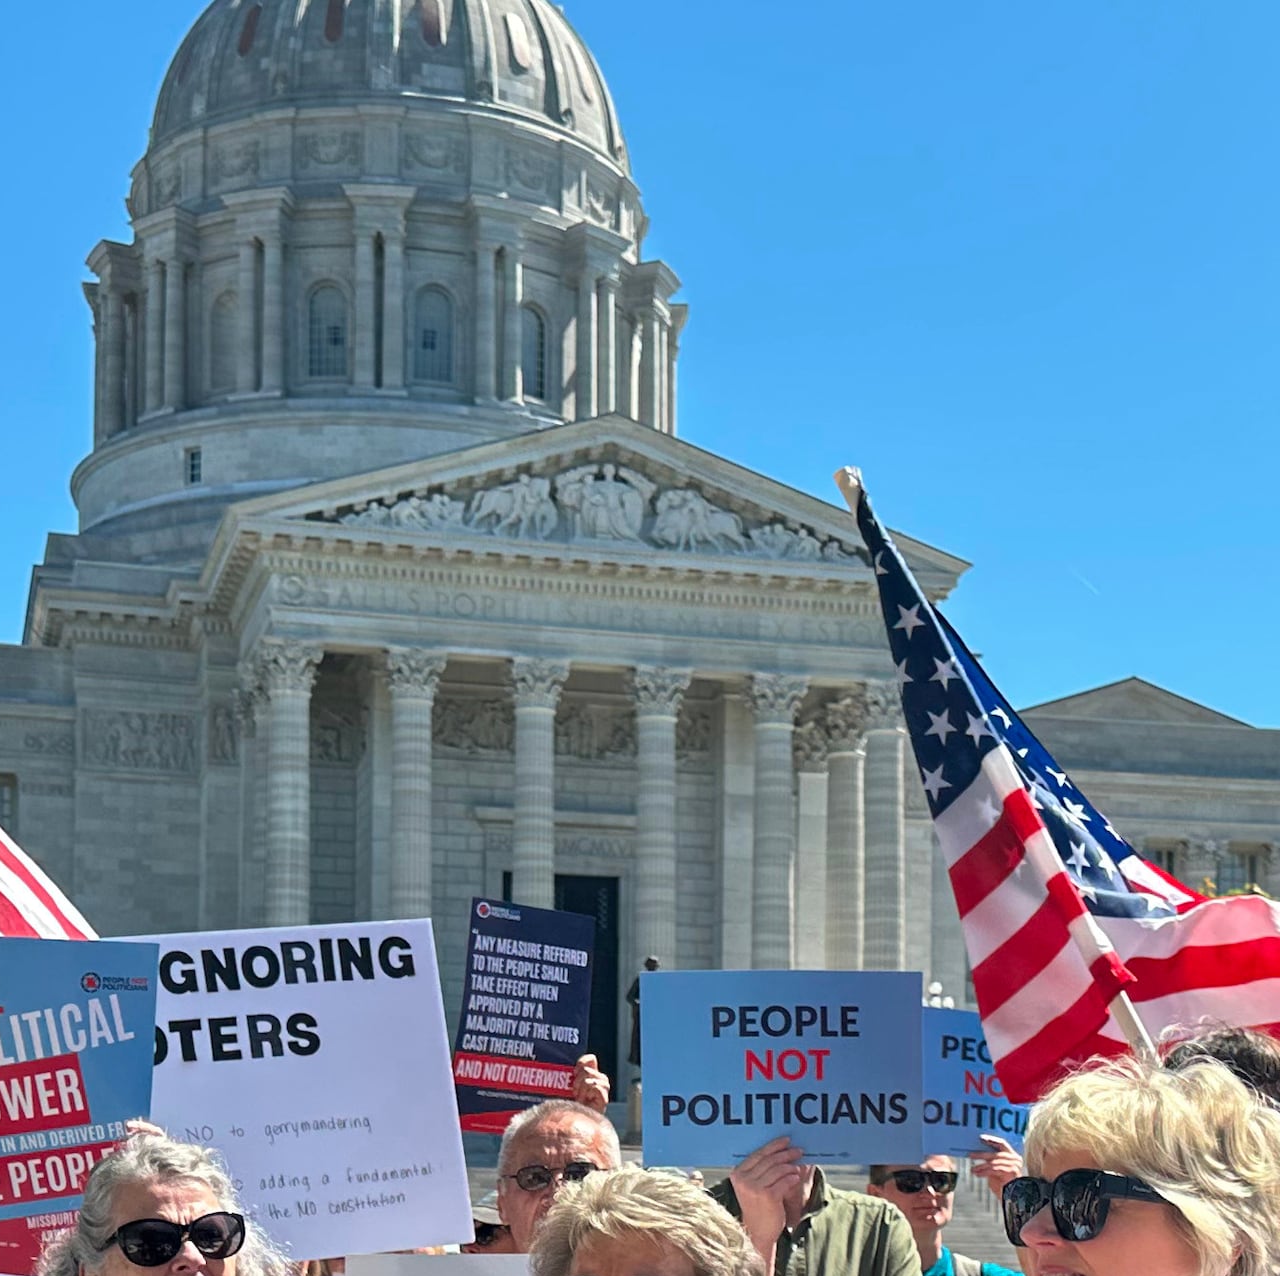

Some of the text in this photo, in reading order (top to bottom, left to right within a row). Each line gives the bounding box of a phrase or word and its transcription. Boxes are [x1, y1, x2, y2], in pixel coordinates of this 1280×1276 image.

[159, 936, 415, 995] GNORING
[497, 938, 588, 967] MEASURE REFERRED
[469, 995, 520, 1015] APPROVED
[466, 1014, 518, 1036] MAJORITY
[711, 1006, 860, 1038] PEOPLE
[154, 1013, 320, 1066] TERS
[744, 1049, 830, 1081] NOT
[661, 1093, 908, 1126] POLITICIANS
[2, 1140, 16, 1153] IN
[21, 1135, 46, 1151] AND
[49, 1127, 105, 1147] DERIVED
[230, 1126, 245, 1138] to
[265, 1116, 372, 1145] gerrymandering
[259, 1163, 433, 1191] adding a fundamental
[26, 1212, 73, 1229] MISSOURI
[268, 1203, 292, 1220] the
